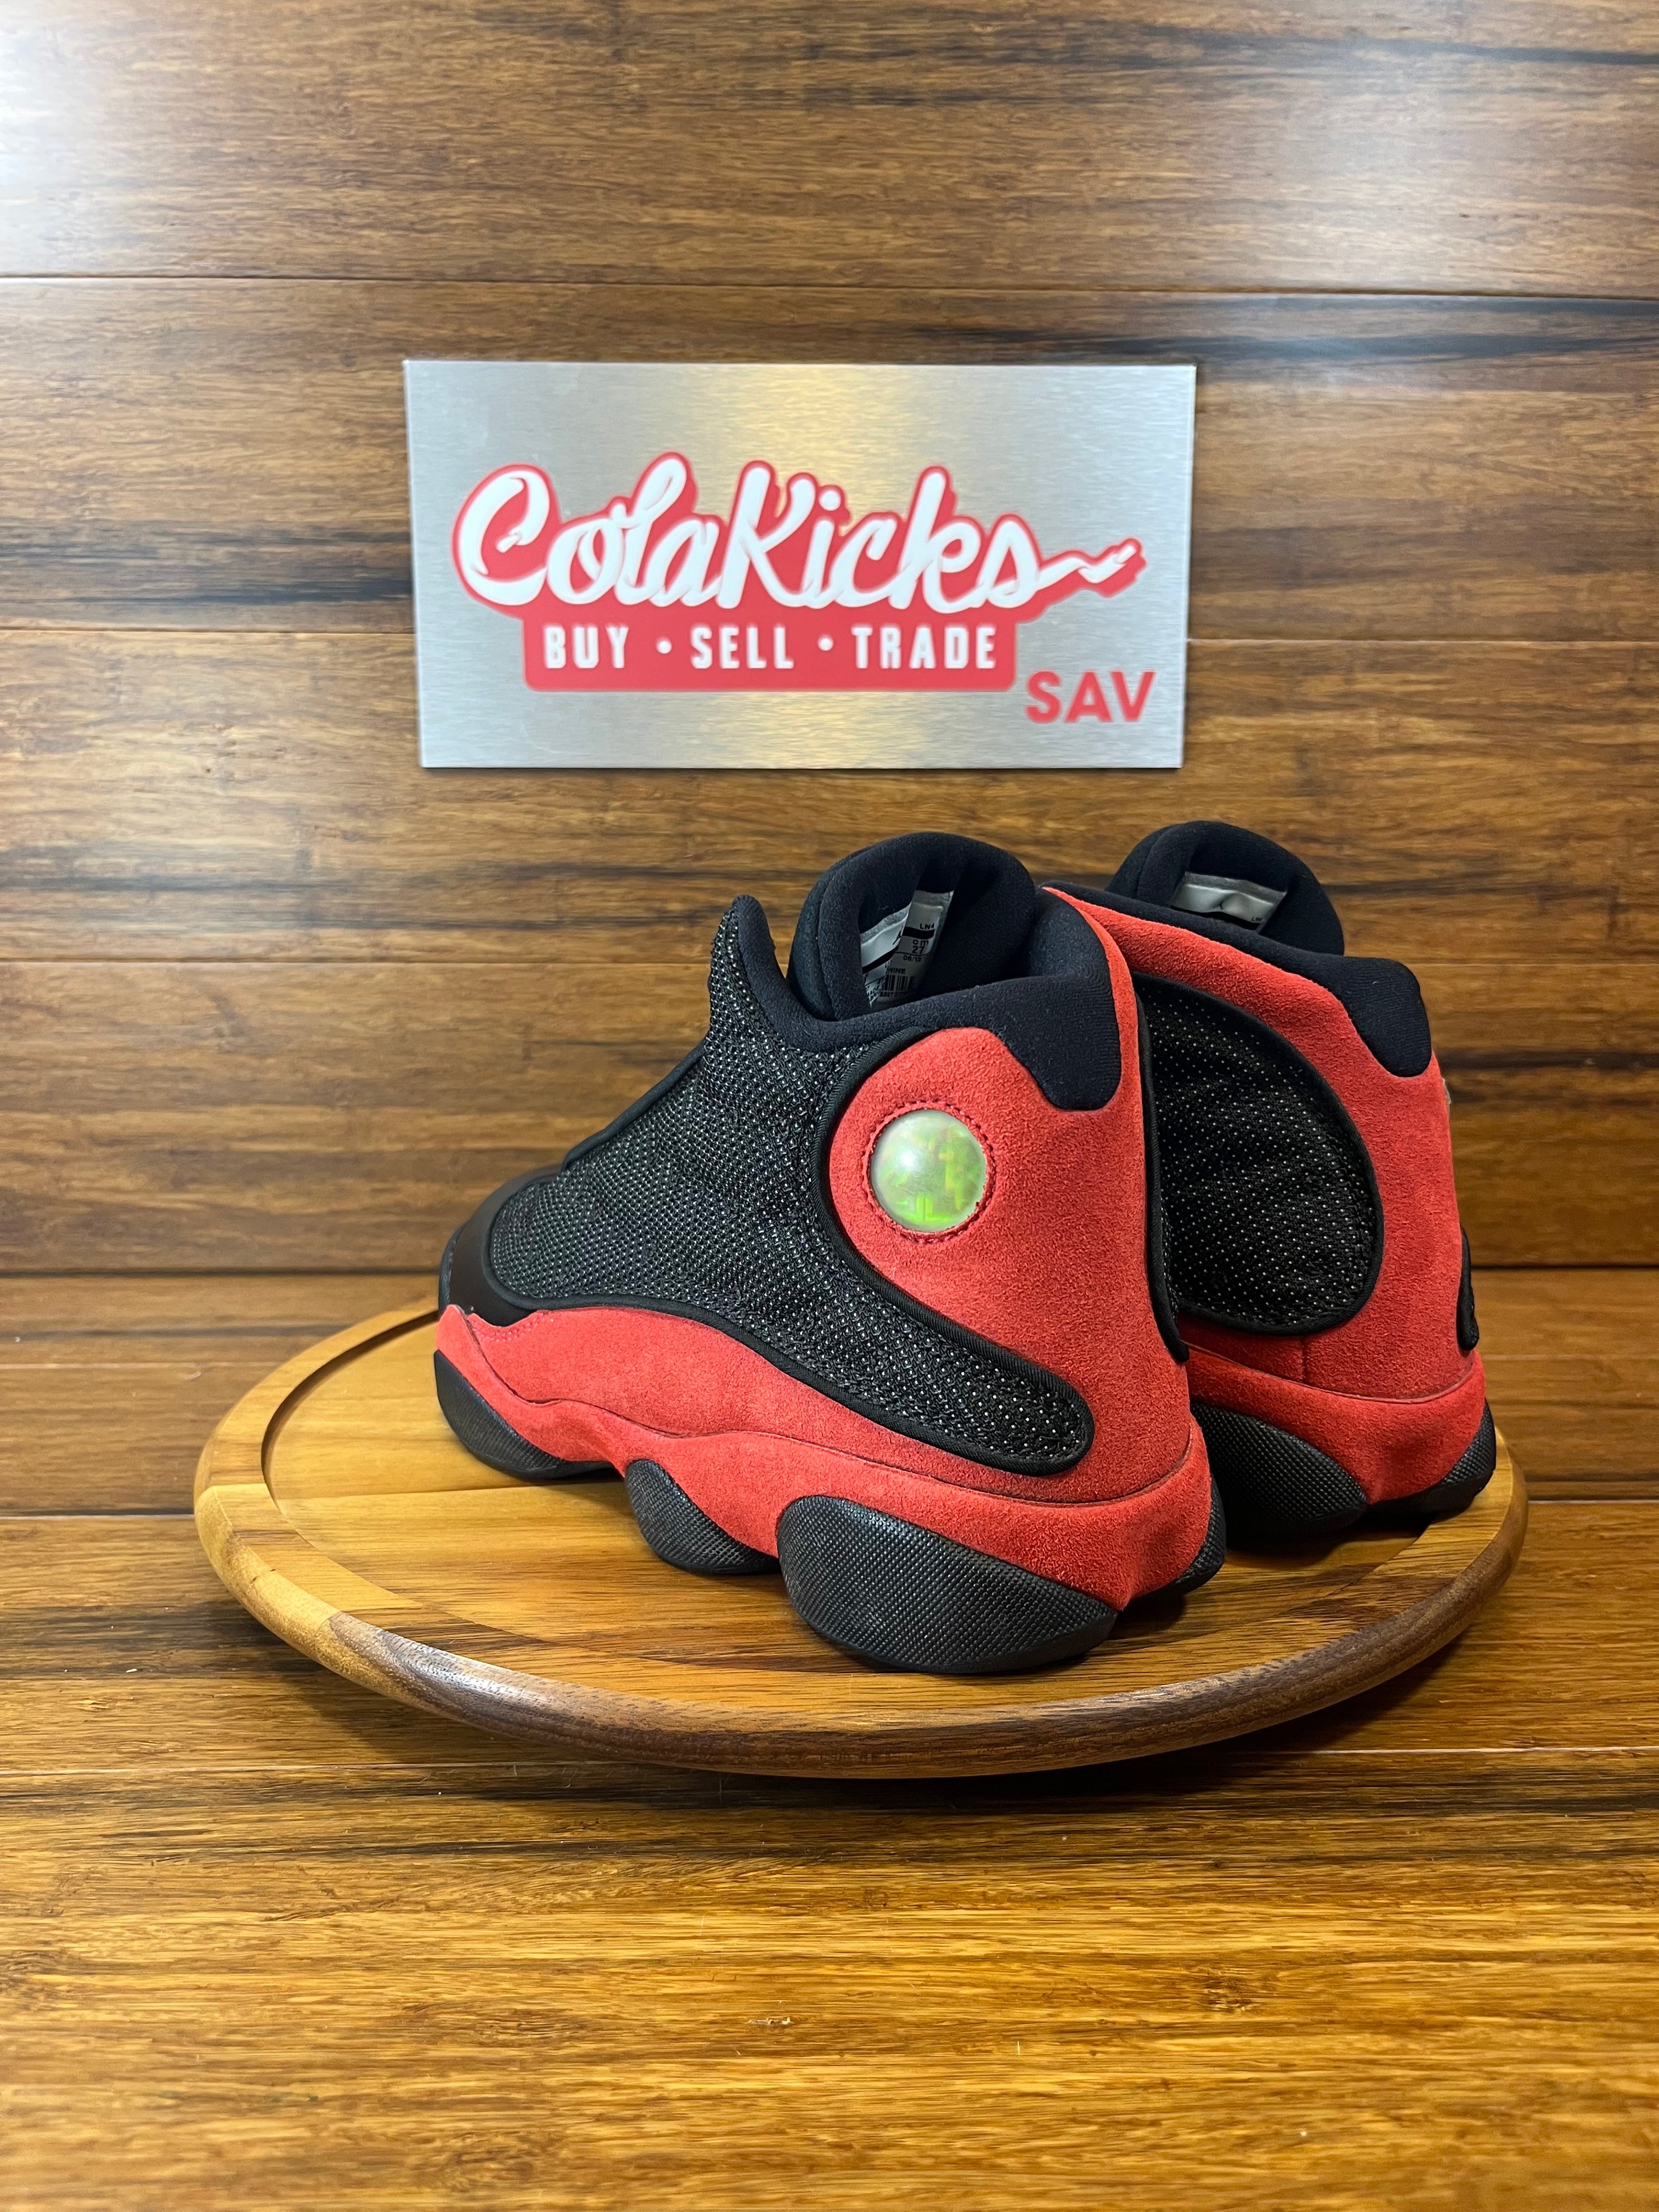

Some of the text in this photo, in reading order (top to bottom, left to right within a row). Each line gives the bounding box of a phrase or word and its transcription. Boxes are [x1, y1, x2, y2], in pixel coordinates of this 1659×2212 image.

[454, 455, 1140, 613] ColaKicks
[543, 624, 996, 669] BUY SELL TRADE
[1025, 670, 1156, 723] SAV
[912, 945, 925, 954] 27
